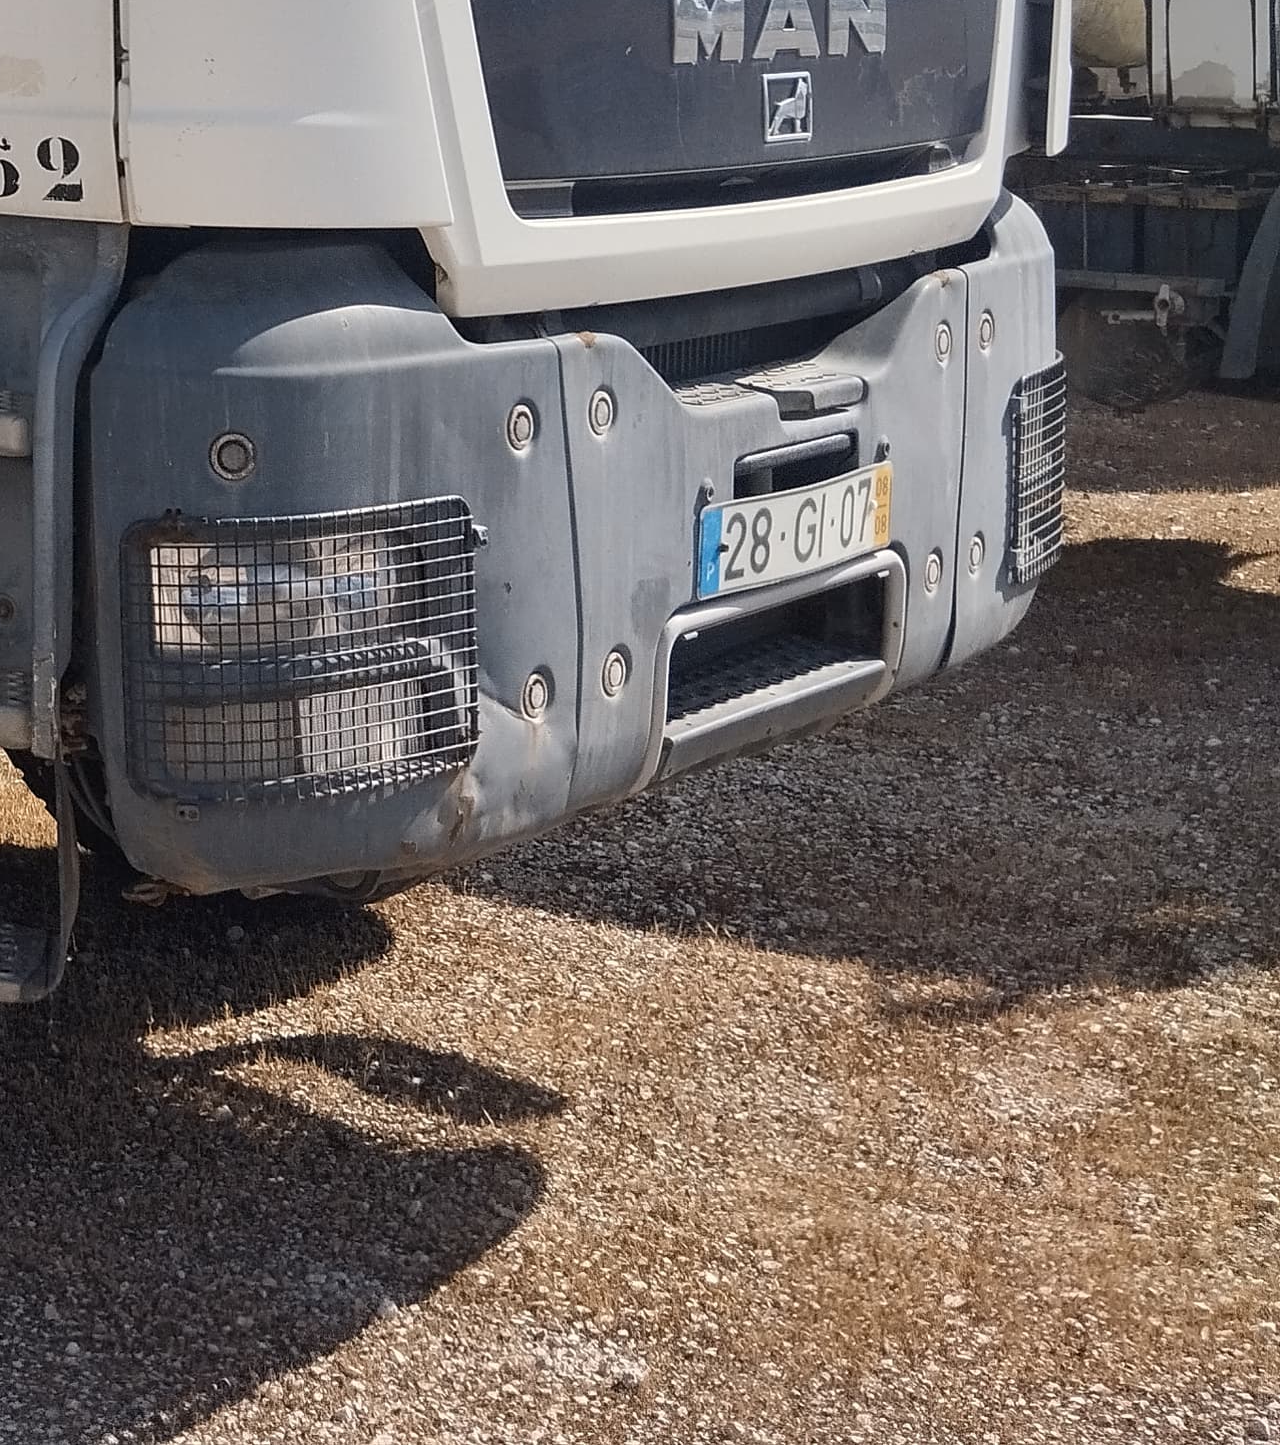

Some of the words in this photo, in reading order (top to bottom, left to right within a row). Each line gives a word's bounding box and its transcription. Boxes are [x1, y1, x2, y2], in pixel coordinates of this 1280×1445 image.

[875, 475, 889, 497] 08
[874, 514, 887, 535] 08
[706, 563, 716, 581] P
